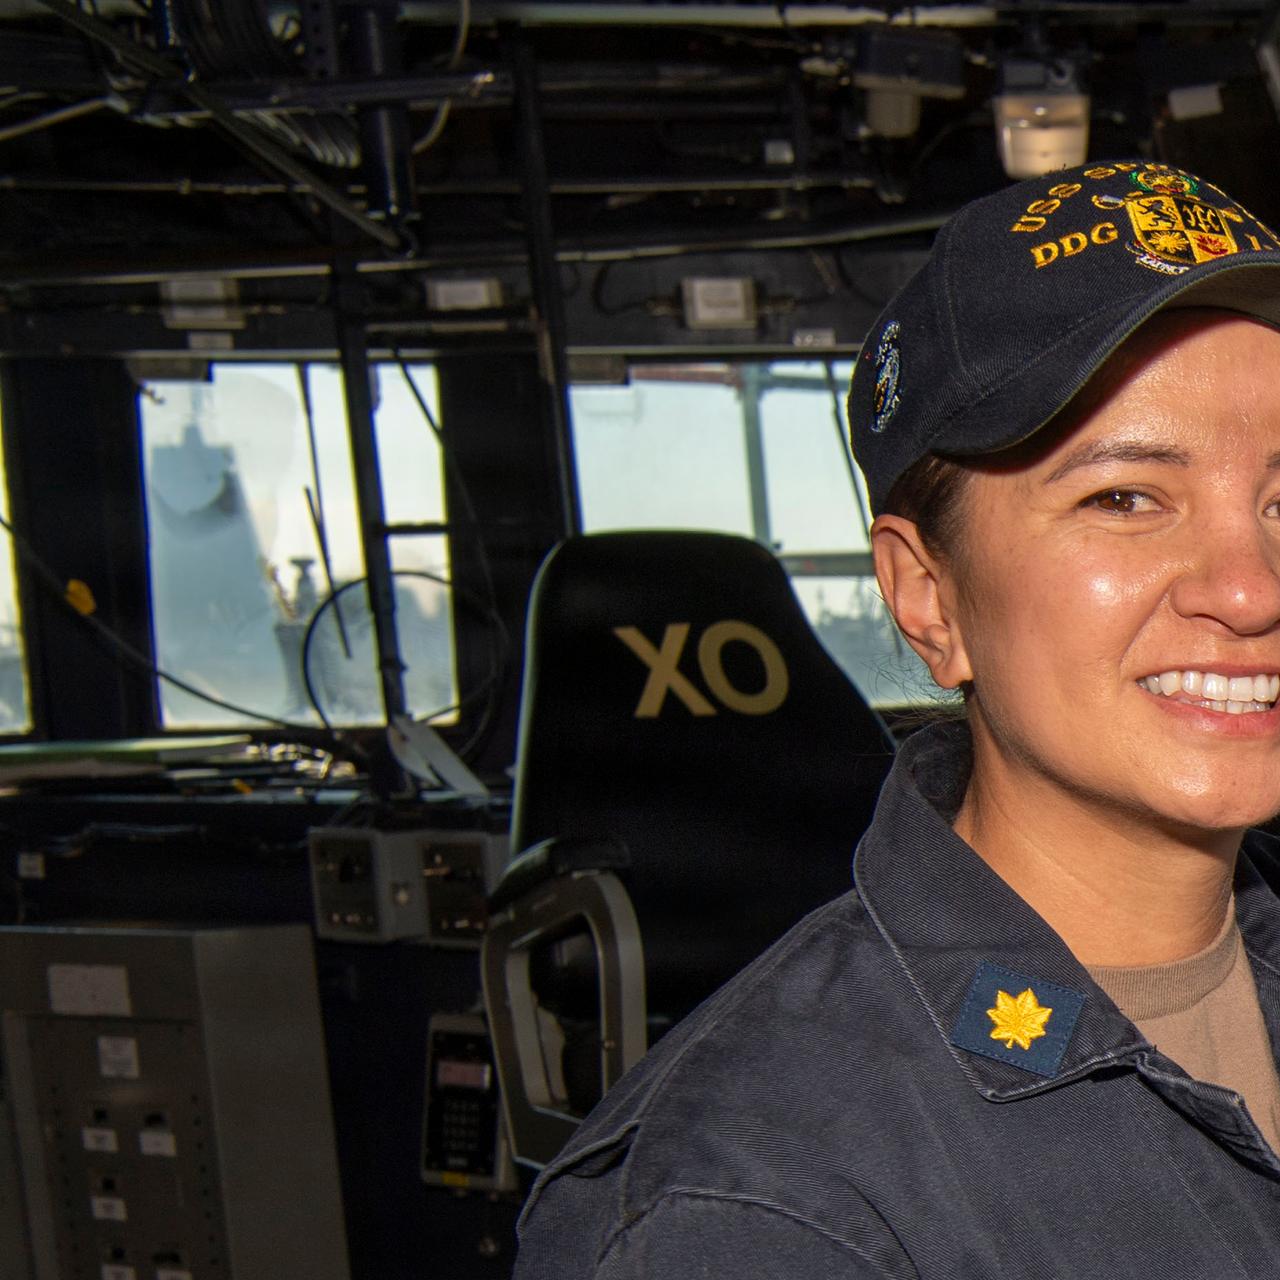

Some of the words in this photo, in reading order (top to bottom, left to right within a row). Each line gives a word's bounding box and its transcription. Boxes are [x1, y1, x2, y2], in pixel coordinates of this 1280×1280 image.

[1011, 183, 1082, 232] USS
[1030, 222, 1119, 269] DDG
[613, 619, 790, 719] XO
